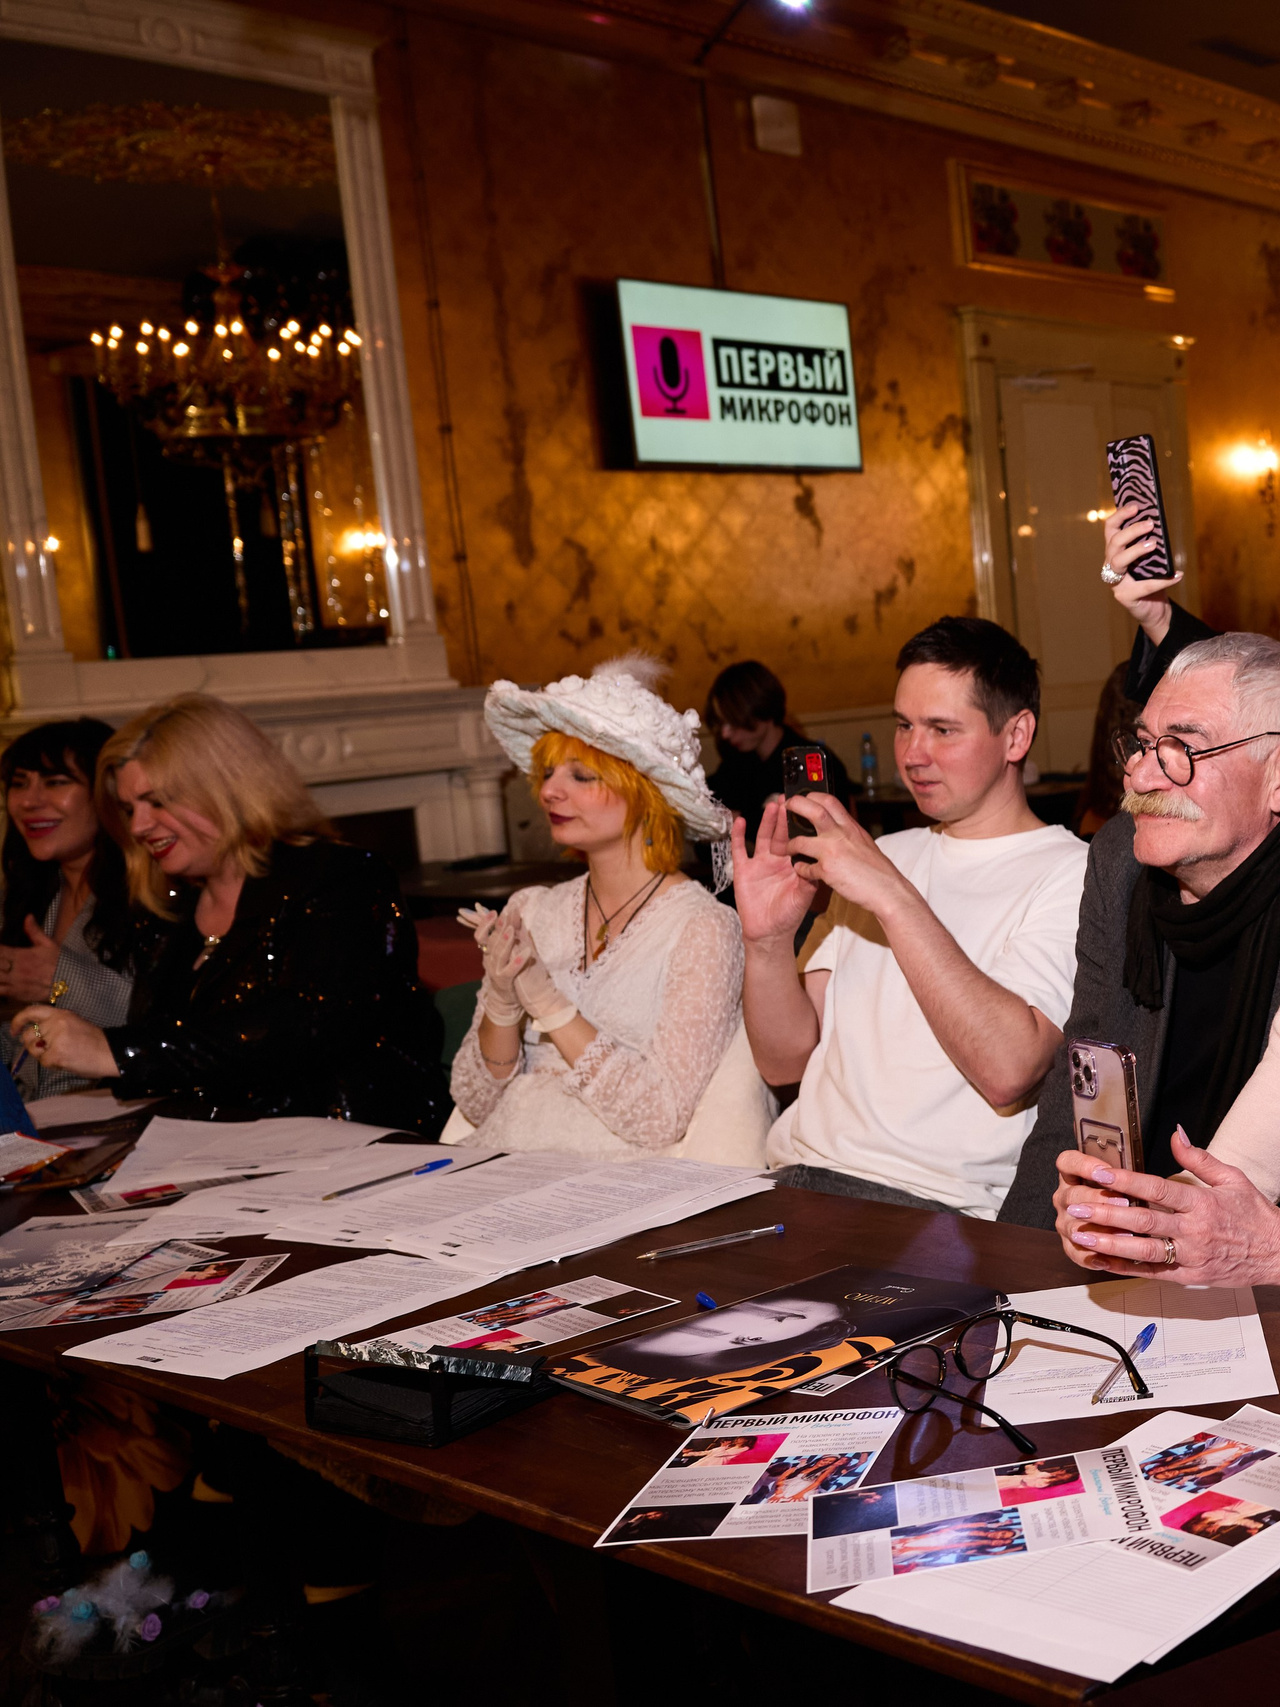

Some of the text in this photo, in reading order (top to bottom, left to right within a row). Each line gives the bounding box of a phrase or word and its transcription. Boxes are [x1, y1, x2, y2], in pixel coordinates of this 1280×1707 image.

[717, 345, 845, 393] ПЕРВЫЙ
[720, 394, 852, 427] МИКРОФОН
[709, 1409, 901, 1430] ПЕРВЫЙ МИКРОФОН
[1100, 1447, 1138, 1482] ПЕРВЫЙ
[1112, 1481, 1152, 1533] МИКРОФОН
[1124, 1536, 1207, 1568] ПЕРВЫЙ
